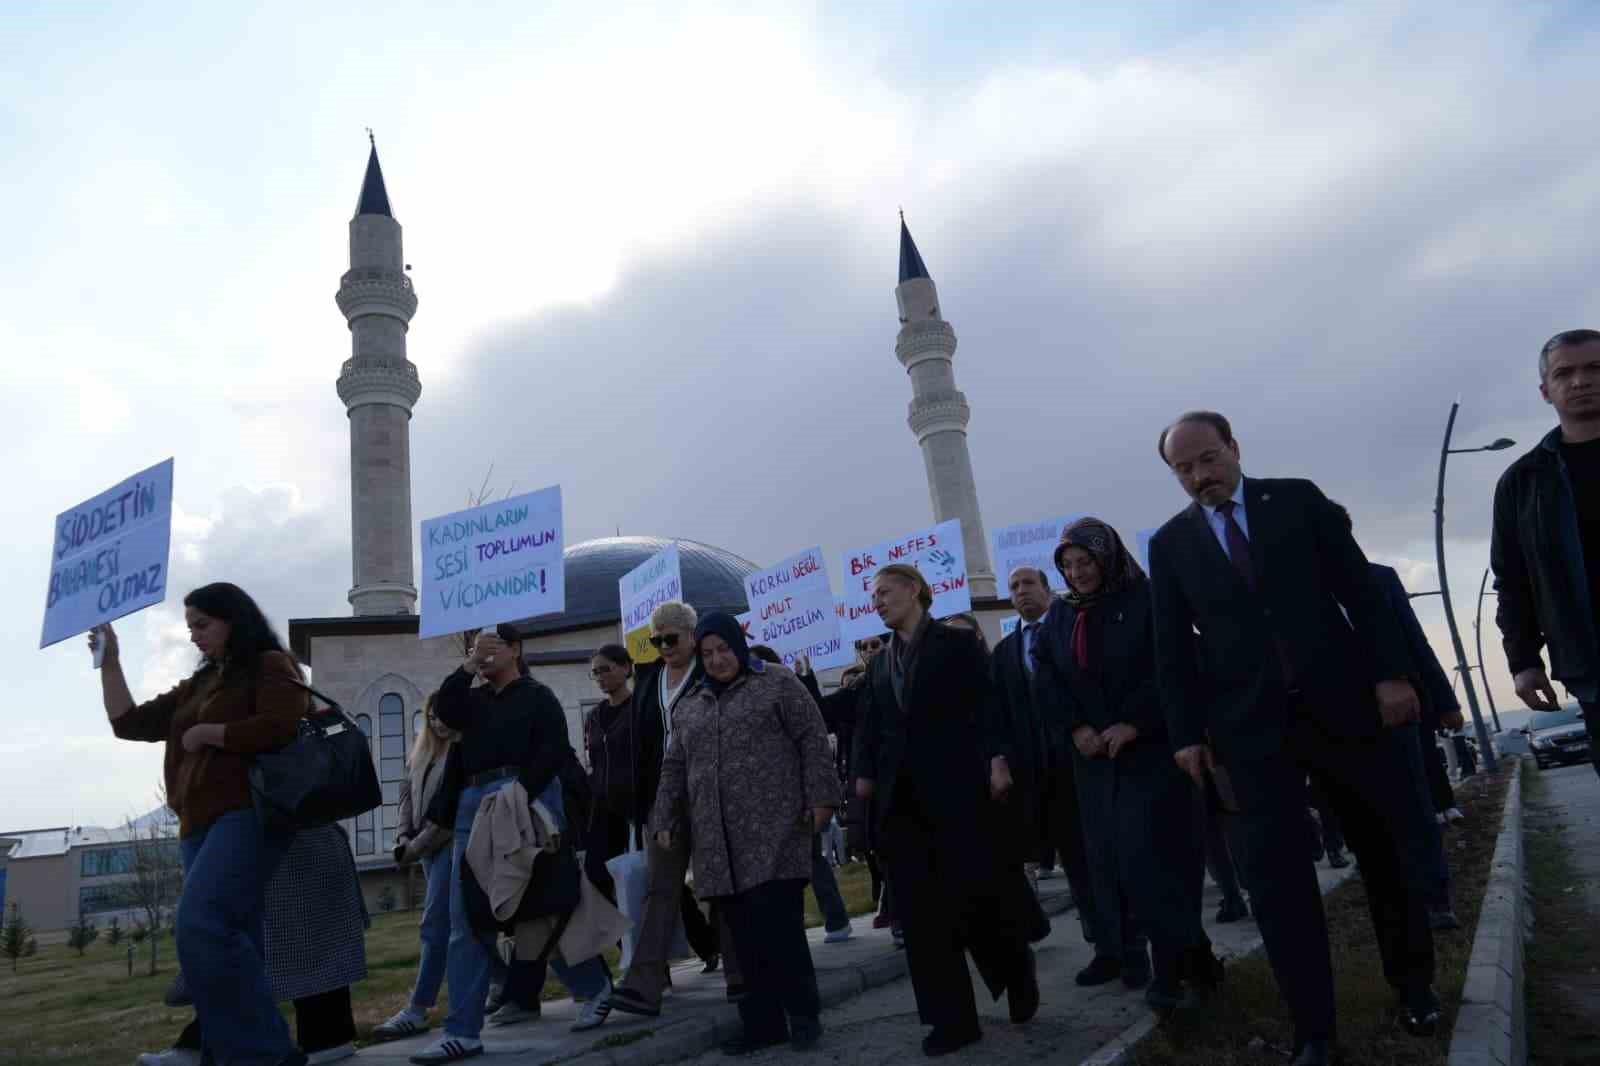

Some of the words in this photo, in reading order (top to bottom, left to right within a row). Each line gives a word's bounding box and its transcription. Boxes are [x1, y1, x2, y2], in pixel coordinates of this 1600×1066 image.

[428, 504, 528, 547] KADINLARIN
[434, 546, 468, 581] SESİ
[475, 528, 555, 562] TOPLUMUN
[851, 552, 876, 575] BİR
[888, 534, 937, 561] NEFES
[98, 563, 164, 614] OLMAZ
[750, 568, 790, 598] KORKU
[760, 597, 792, 620] UMUT
